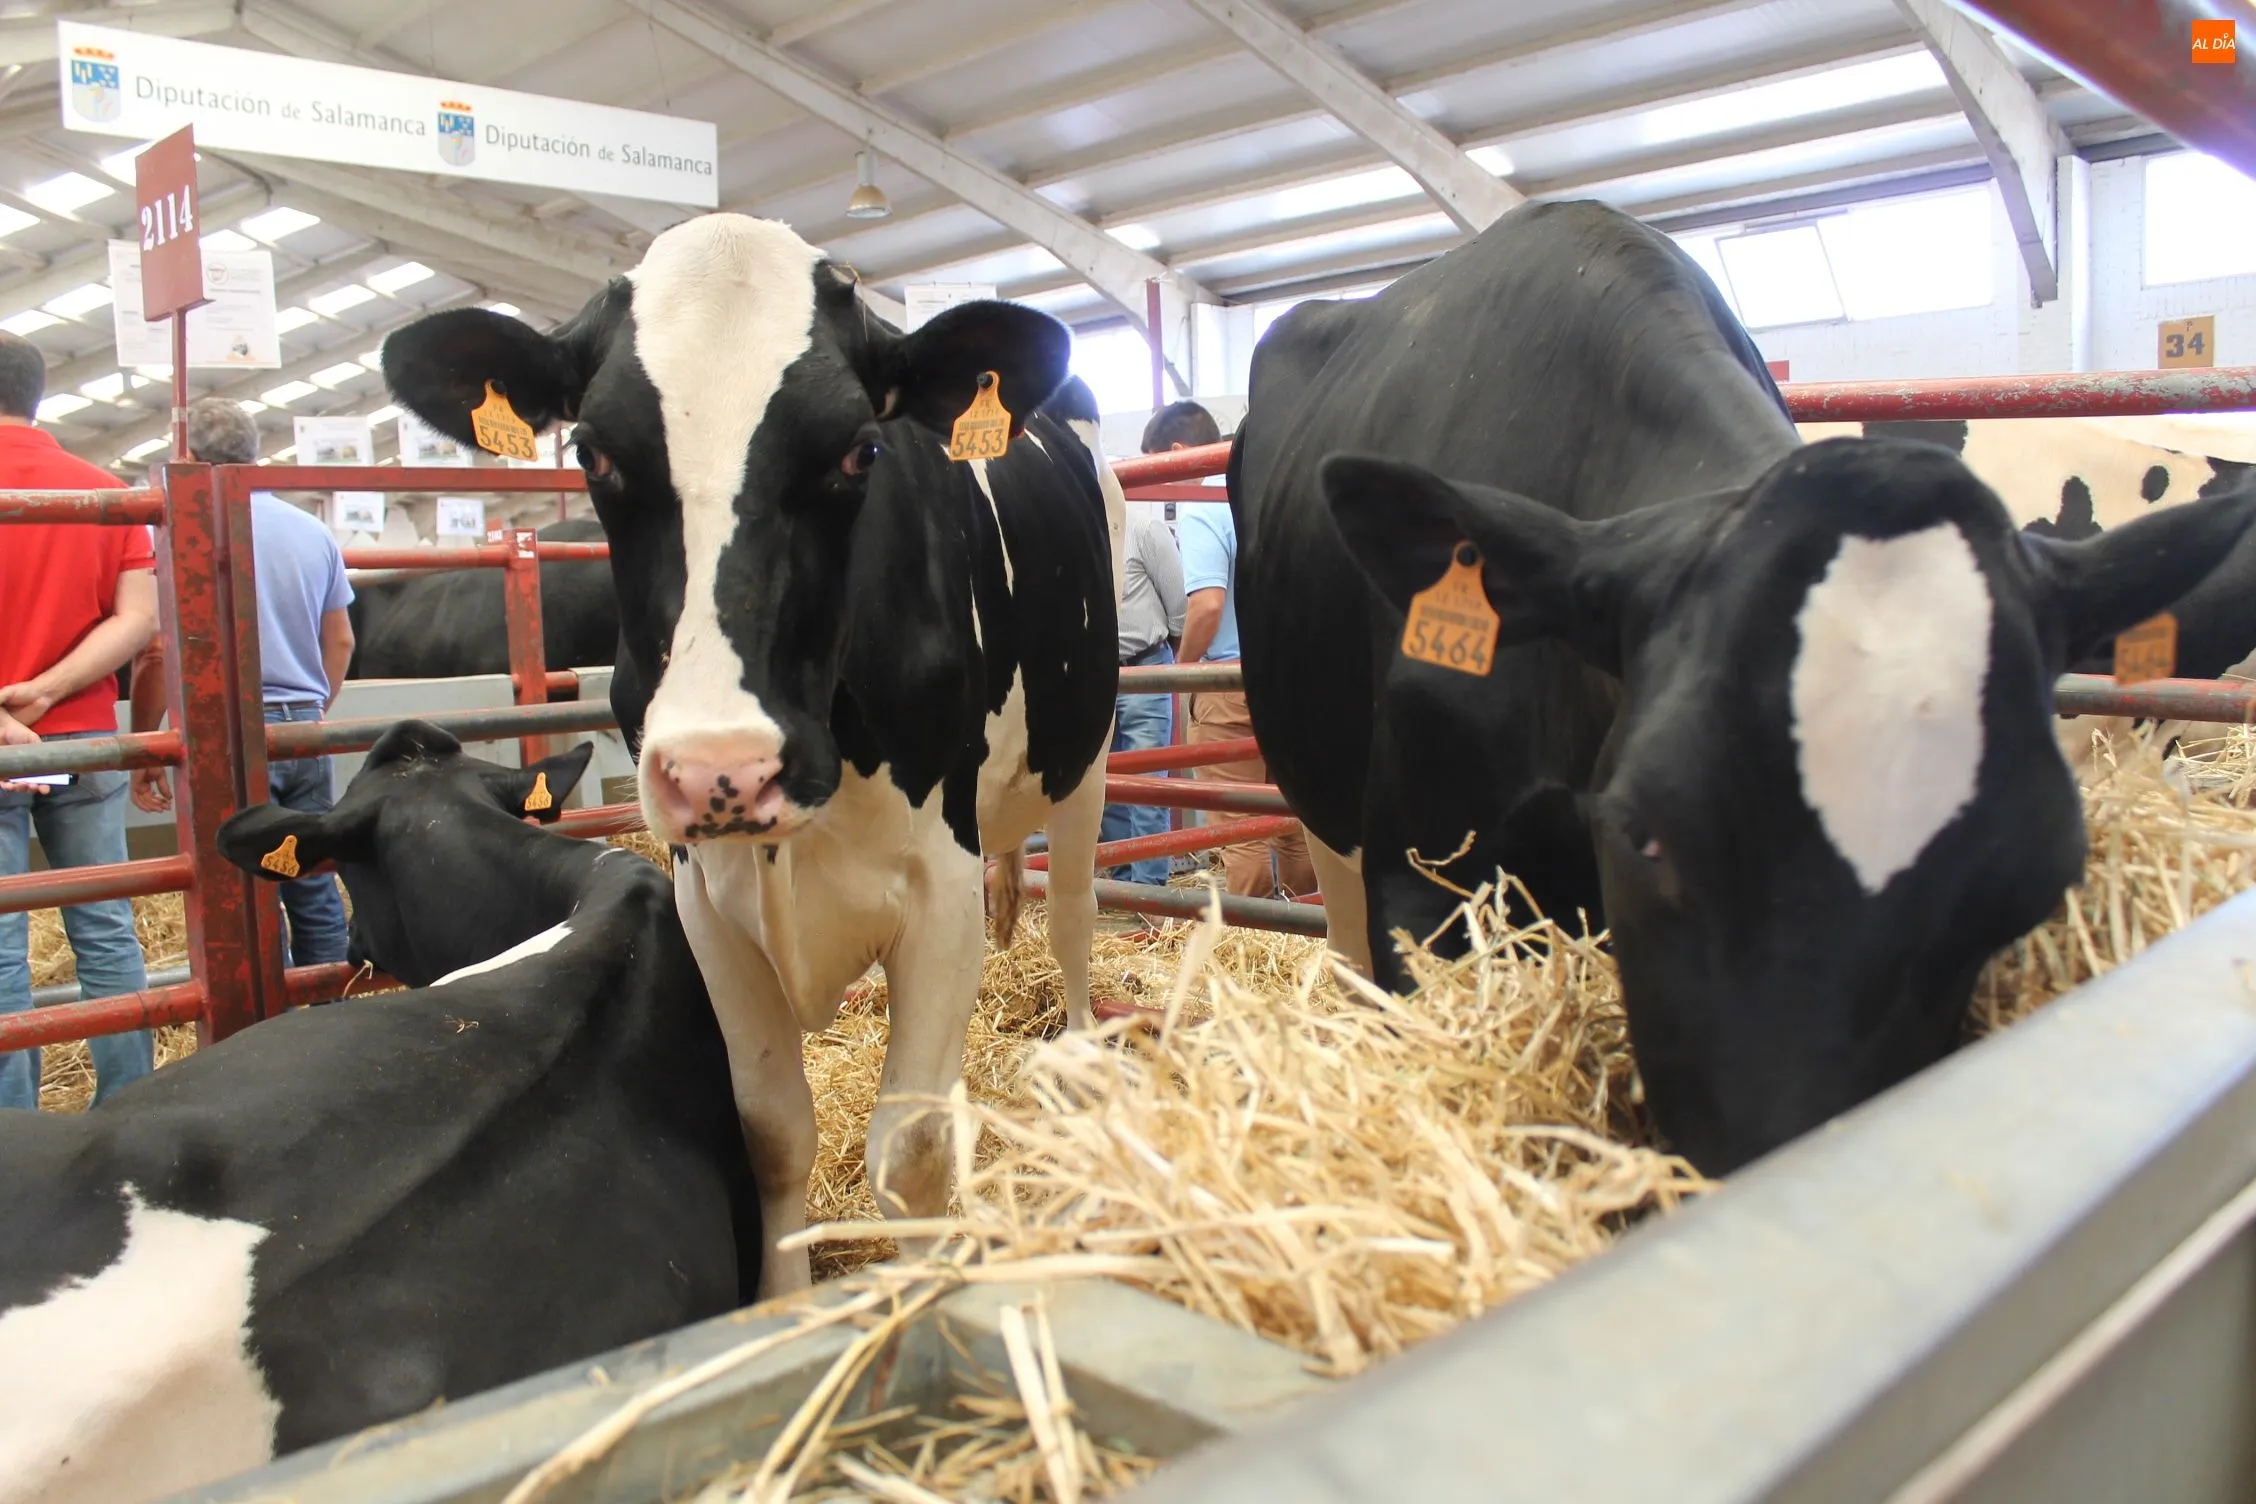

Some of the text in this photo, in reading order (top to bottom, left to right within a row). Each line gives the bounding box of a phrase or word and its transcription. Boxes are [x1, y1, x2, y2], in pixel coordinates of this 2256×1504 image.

[135, 76, 426, 137] Diputación de Salamanca
[485, 124, 713, 176] Diputación de Salamanca
[141, 185, 194, 251] 2114
[2165, 332, 2206, 358] 34
[480, 425, 534, 459] 5453
[951, 428, 1005, 457] 5453
[1408, 619, 1487, 670] 5464
[265, 855, 298, 875] 5456
